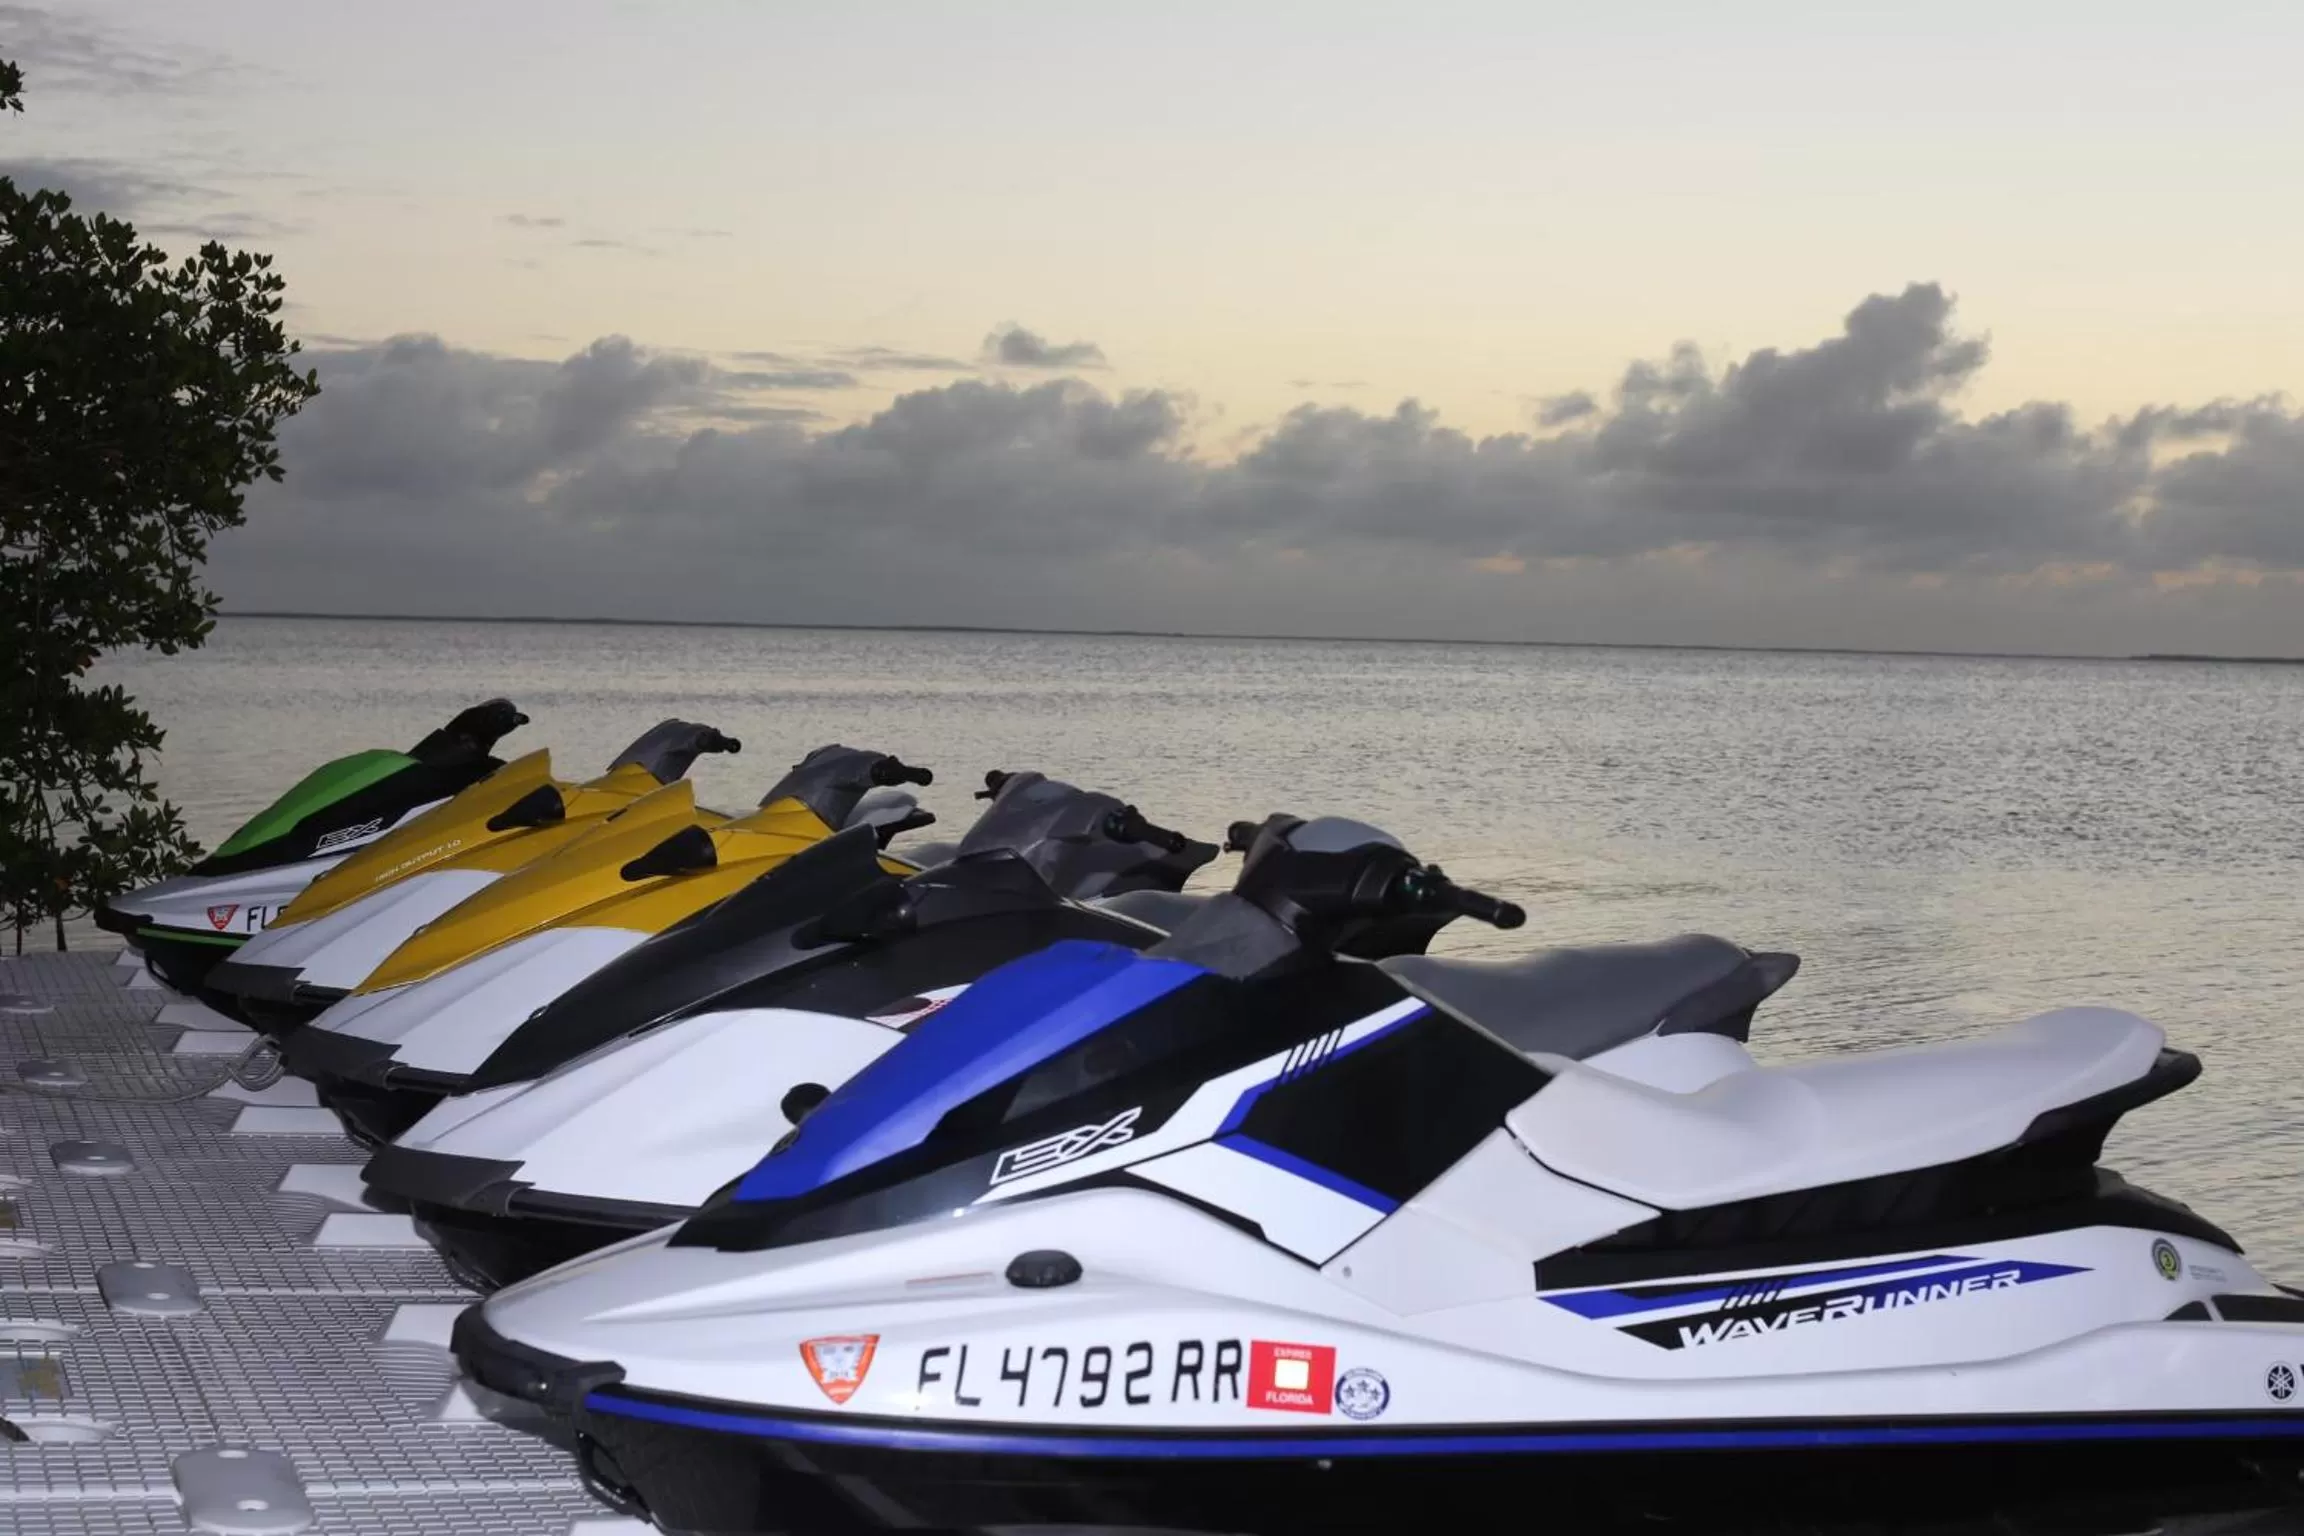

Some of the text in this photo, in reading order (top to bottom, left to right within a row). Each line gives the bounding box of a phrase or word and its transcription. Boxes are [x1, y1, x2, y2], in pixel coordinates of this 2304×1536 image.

[989, 1105, 1143, 1185] EX
[917, 1339, 1243, 1408] FL 4792 RR
[1265, 1391, 1315, 1406] FLORIDA
